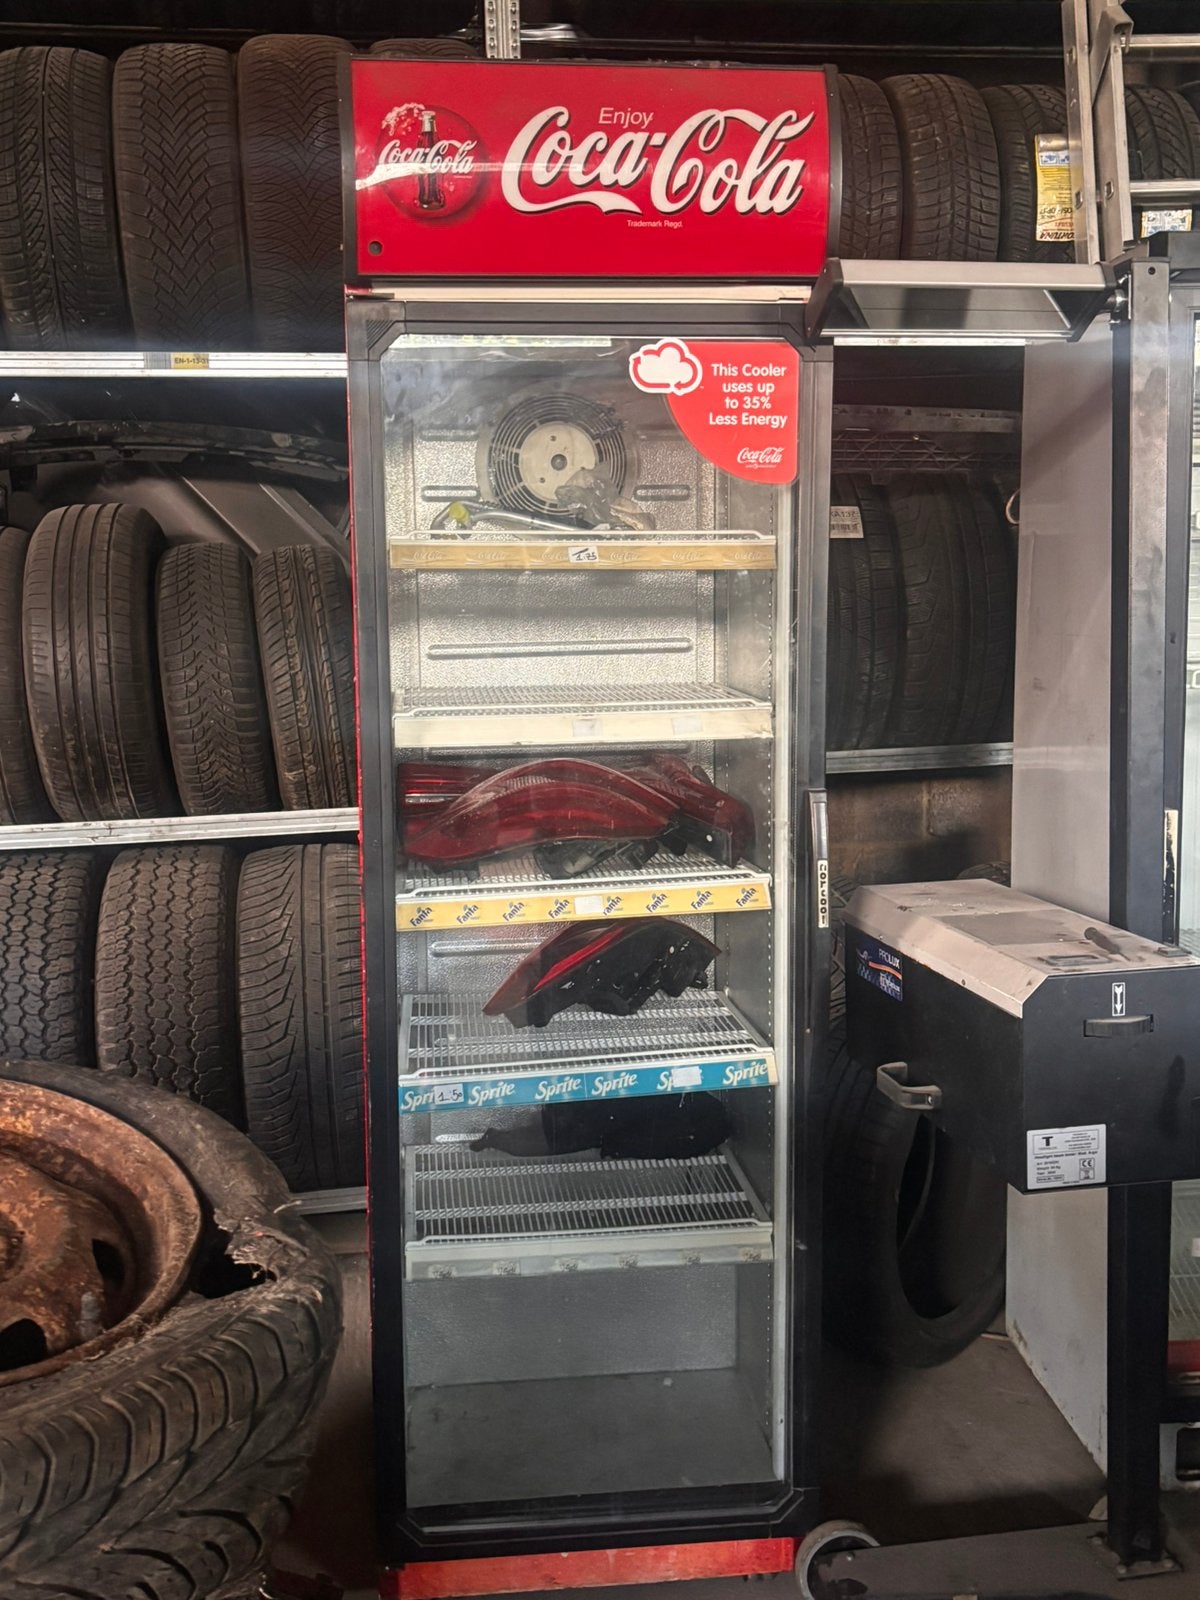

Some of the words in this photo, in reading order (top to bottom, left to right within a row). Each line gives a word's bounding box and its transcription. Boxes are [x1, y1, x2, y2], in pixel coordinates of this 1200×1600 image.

[599, 107, 654, 128] Enjoy
[379, 139, 478, 174] Coca-Cola
[501, 105, 815, 214] Coca-Cola
[626, 219, 663, 228] Trademark
[1040, 231, 1075, 239] ORTUNA
[711, 363, 738, 377] This
[742, 363, 787, 377] Cooler
[722, 382, 753, 393] uses
[757, 382, 775, 396] up
[725, 396, 739, 409] to
[743, 396, 772, 409] 35%
[709, 412, 738, 425] Less
[741, 412, 787, 428] Energy
[737, 447, 785, 463] Coca-Cola
[645, 893, 667, 913] Fanta
[691, 890, 713, 911] Fanta
[736, 887, 757, 907] Fanta
[410, 906, 433, 927] Fanta
[456, 904, 479, 924] Fanta
[502, 901, 525, 922] Fanta
[549, 899, 570, 919] Fanta
[592, 1071, 638, 1096] Sprite
[722, 1061, 768, 1086] Sprite
[468, 1081, 515, 1106] Sprite
[535, 1076, 582, 1101] Sprite
[401, 1090, 435, 1111] Spri
[1042, 1135, 1053, 1146] T
